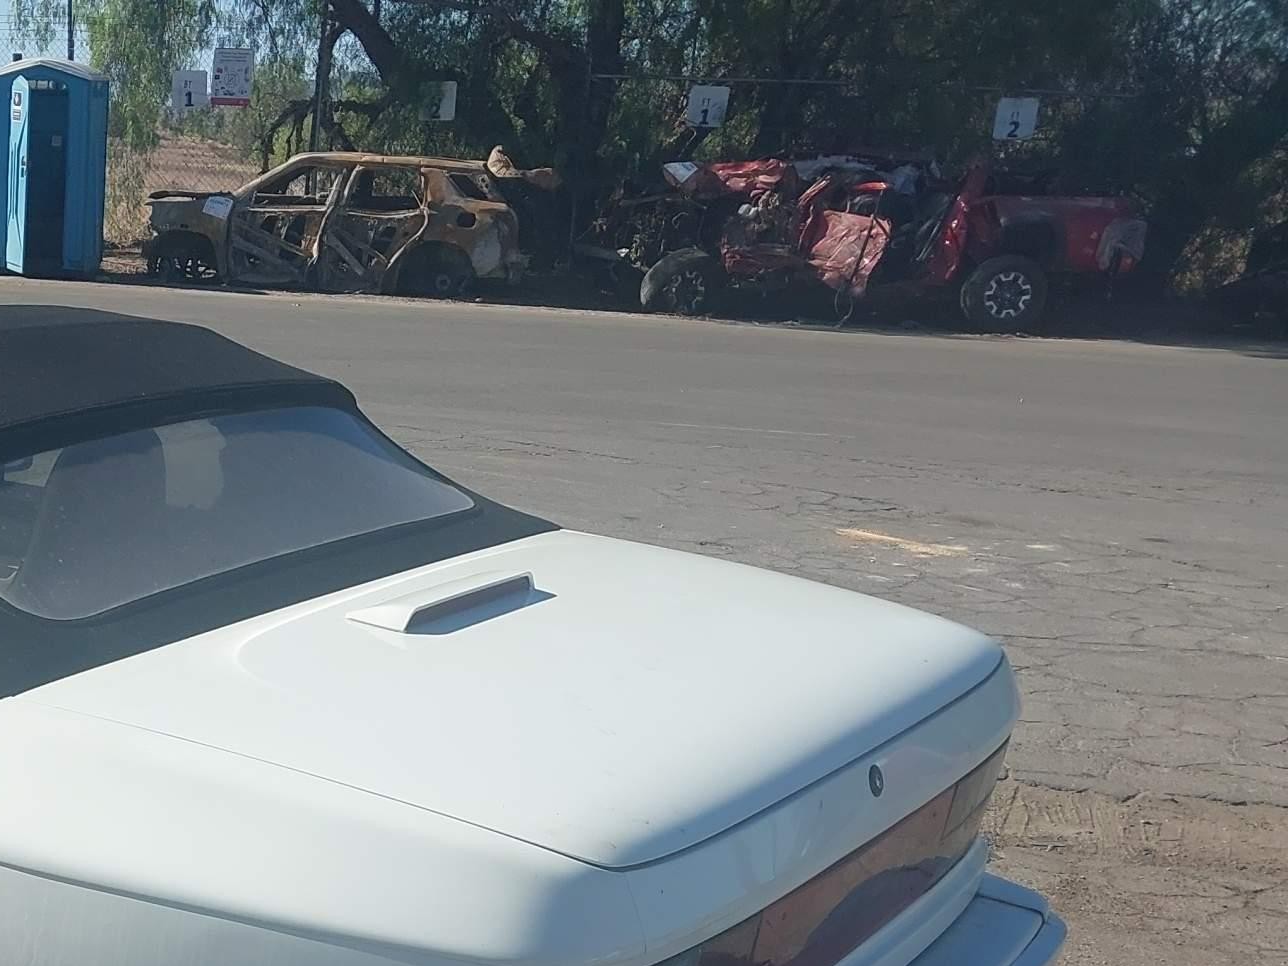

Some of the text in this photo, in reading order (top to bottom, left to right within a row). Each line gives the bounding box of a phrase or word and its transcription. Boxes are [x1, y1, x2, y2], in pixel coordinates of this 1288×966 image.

[185, 91, 194, 107] 1
[699, 108, 709, 125] 1
[1007, 121, 1020, 138] 2
